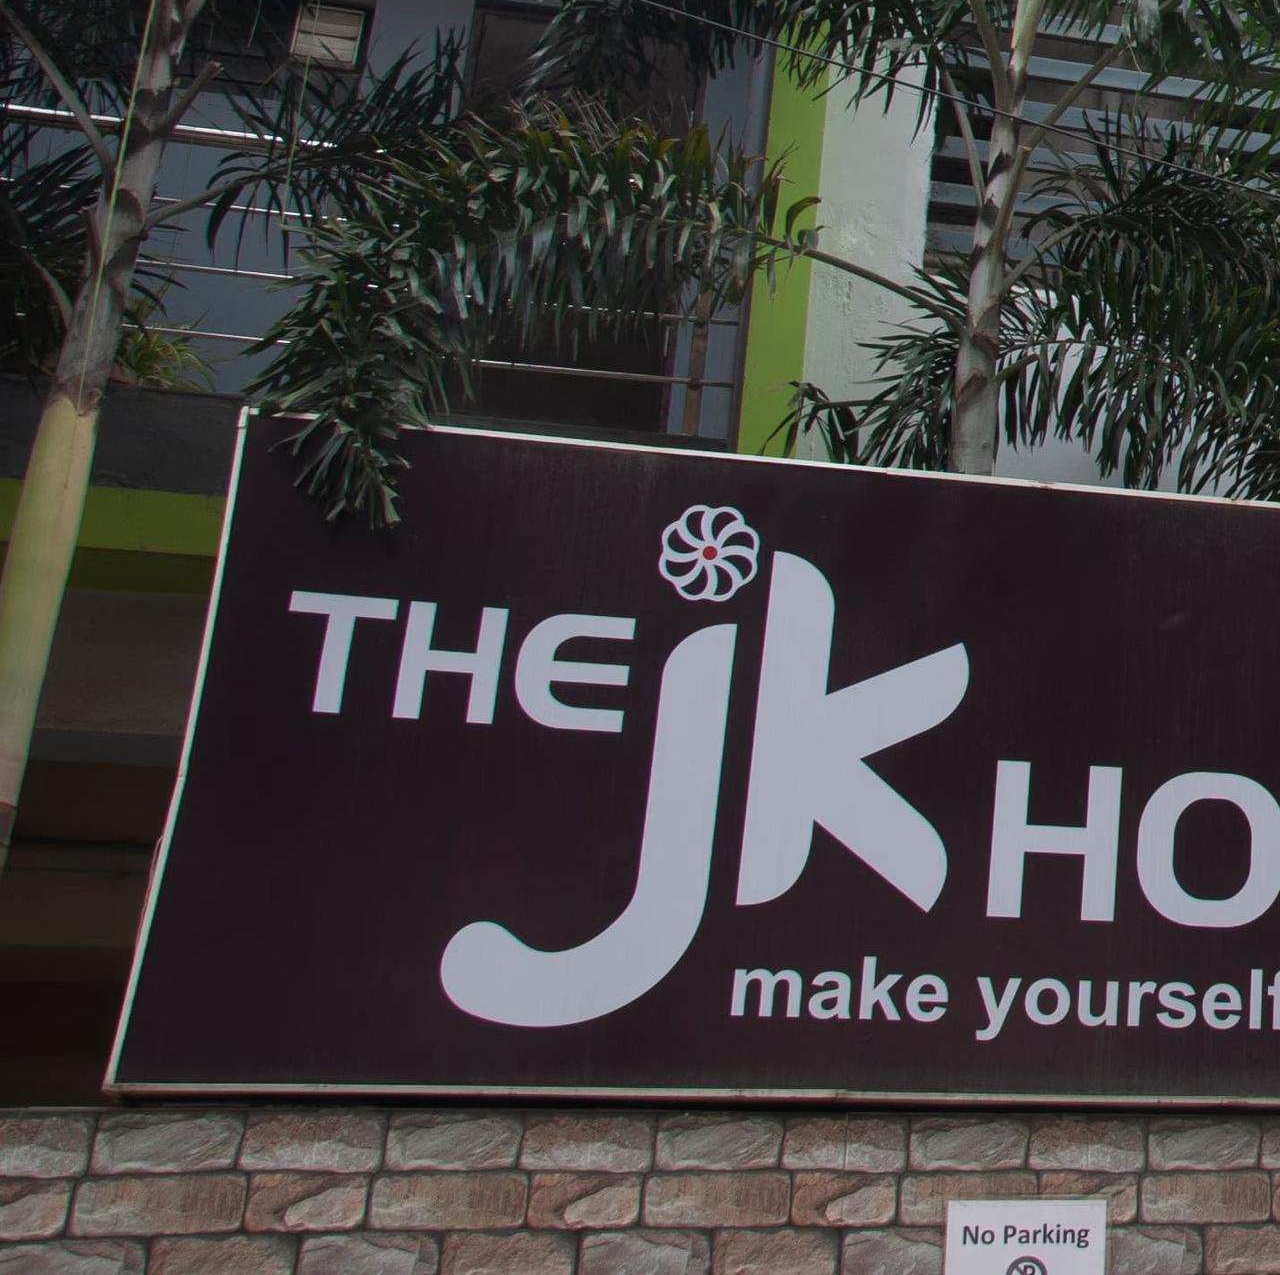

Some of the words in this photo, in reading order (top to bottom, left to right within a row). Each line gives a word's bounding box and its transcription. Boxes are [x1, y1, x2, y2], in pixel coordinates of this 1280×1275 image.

[289, 591, 635, 732] THE
[731, 957, 949, 1023] make
[962, 1225, 995, 1245] No
[1003, 1223, 1090, 1248] Parking
